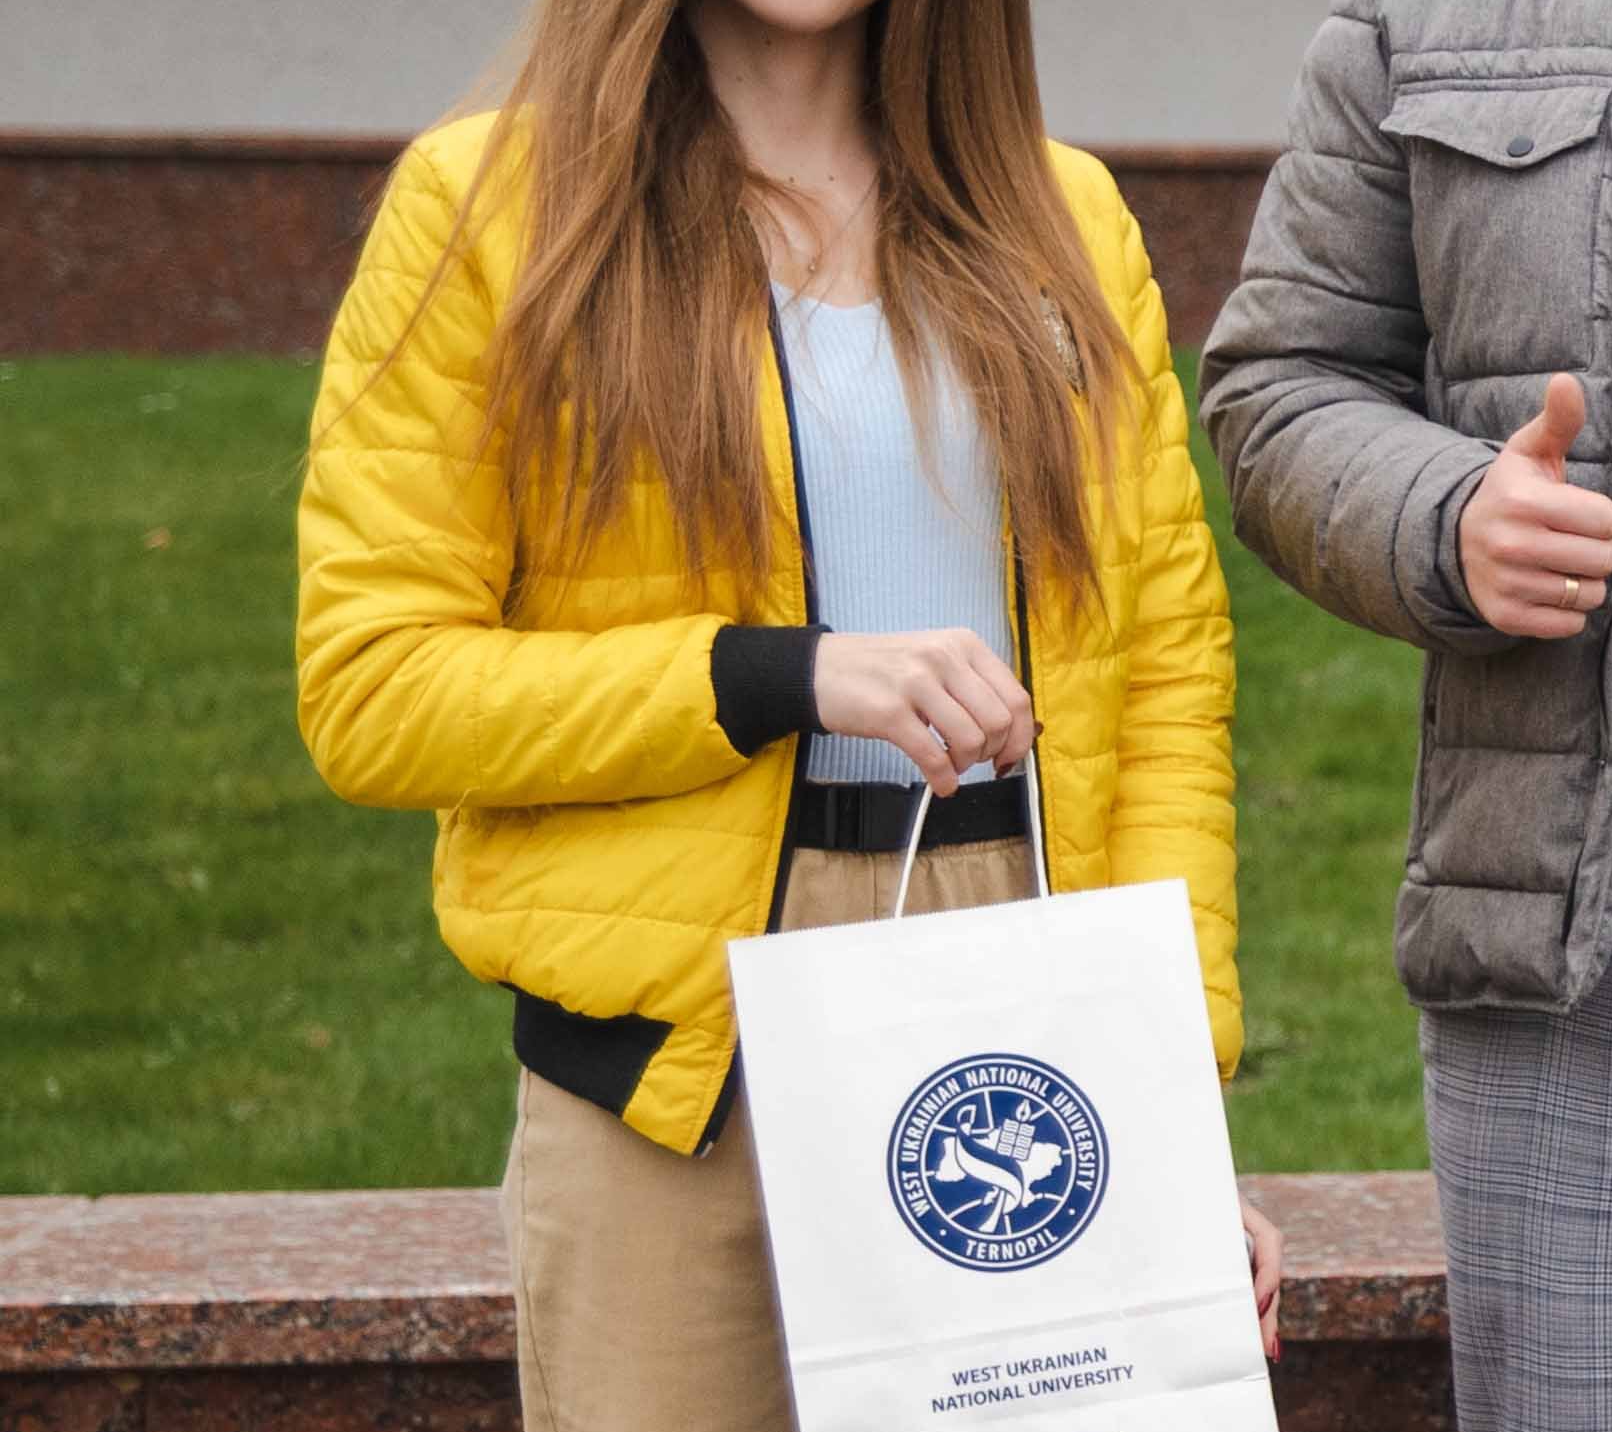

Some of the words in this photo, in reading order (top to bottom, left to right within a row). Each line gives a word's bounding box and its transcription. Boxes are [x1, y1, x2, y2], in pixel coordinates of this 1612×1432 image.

[965, 1066, 1050, 1098] NATIONAL
[901, 1077, 962, 1162] UKRAINIAN
[1052, 1091, 1096, 1192] UNIVERSITY
[901, 1170, 932, 1218] WEST
[965, 1227, 1060, 1261] TERNOPIL
[931, 1385, 1025, 1414] NATIONAL
[1028, 1364, 1134, 1398] UNIVERSITY
[951, 1364, 1001, 1387] WEST
[1006, 1346, 1108, 1378] UKRAINIAN
